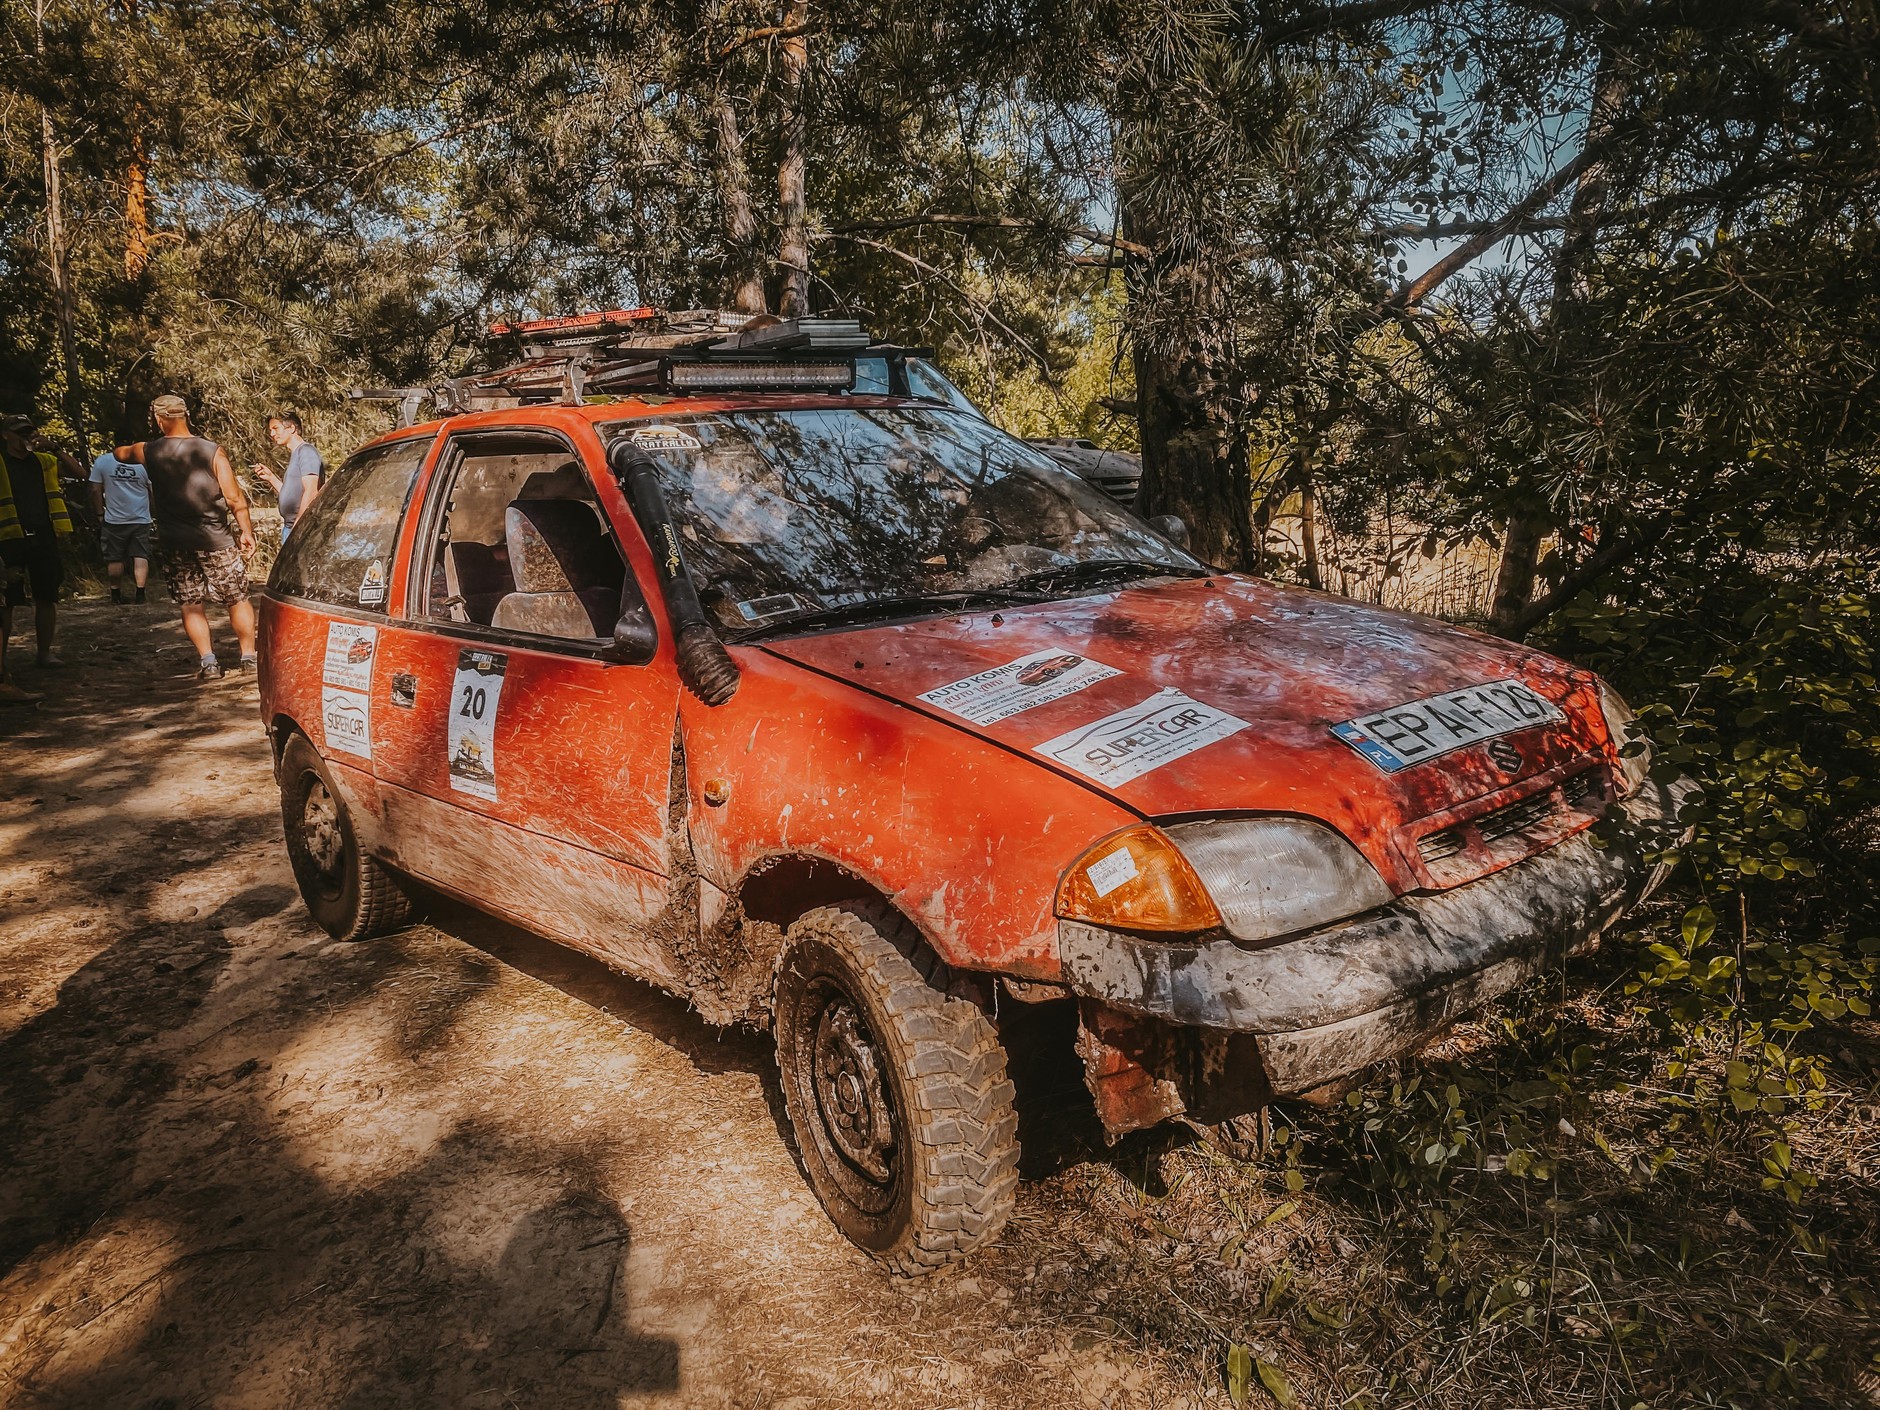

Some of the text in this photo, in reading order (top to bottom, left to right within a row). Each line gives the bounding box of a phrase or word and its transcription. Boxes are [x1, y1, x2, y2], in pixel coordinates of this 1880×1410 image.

[662, 439, 693, 447] RALLY
[926, 681, 971, 701] AUTO
[970, 663, 1022, 684] KOMIS
[459, 684, 487, 720] 20
[982, 716, 1000, 725] tel.
[999, 707, 1020, 717] 663
[1019, 700, 1039, 709] 082
[1038, 694, 1058, 702] 581
[1063, 685, 1082, 693] 601
[1370, 749, 1393, 764] PL
